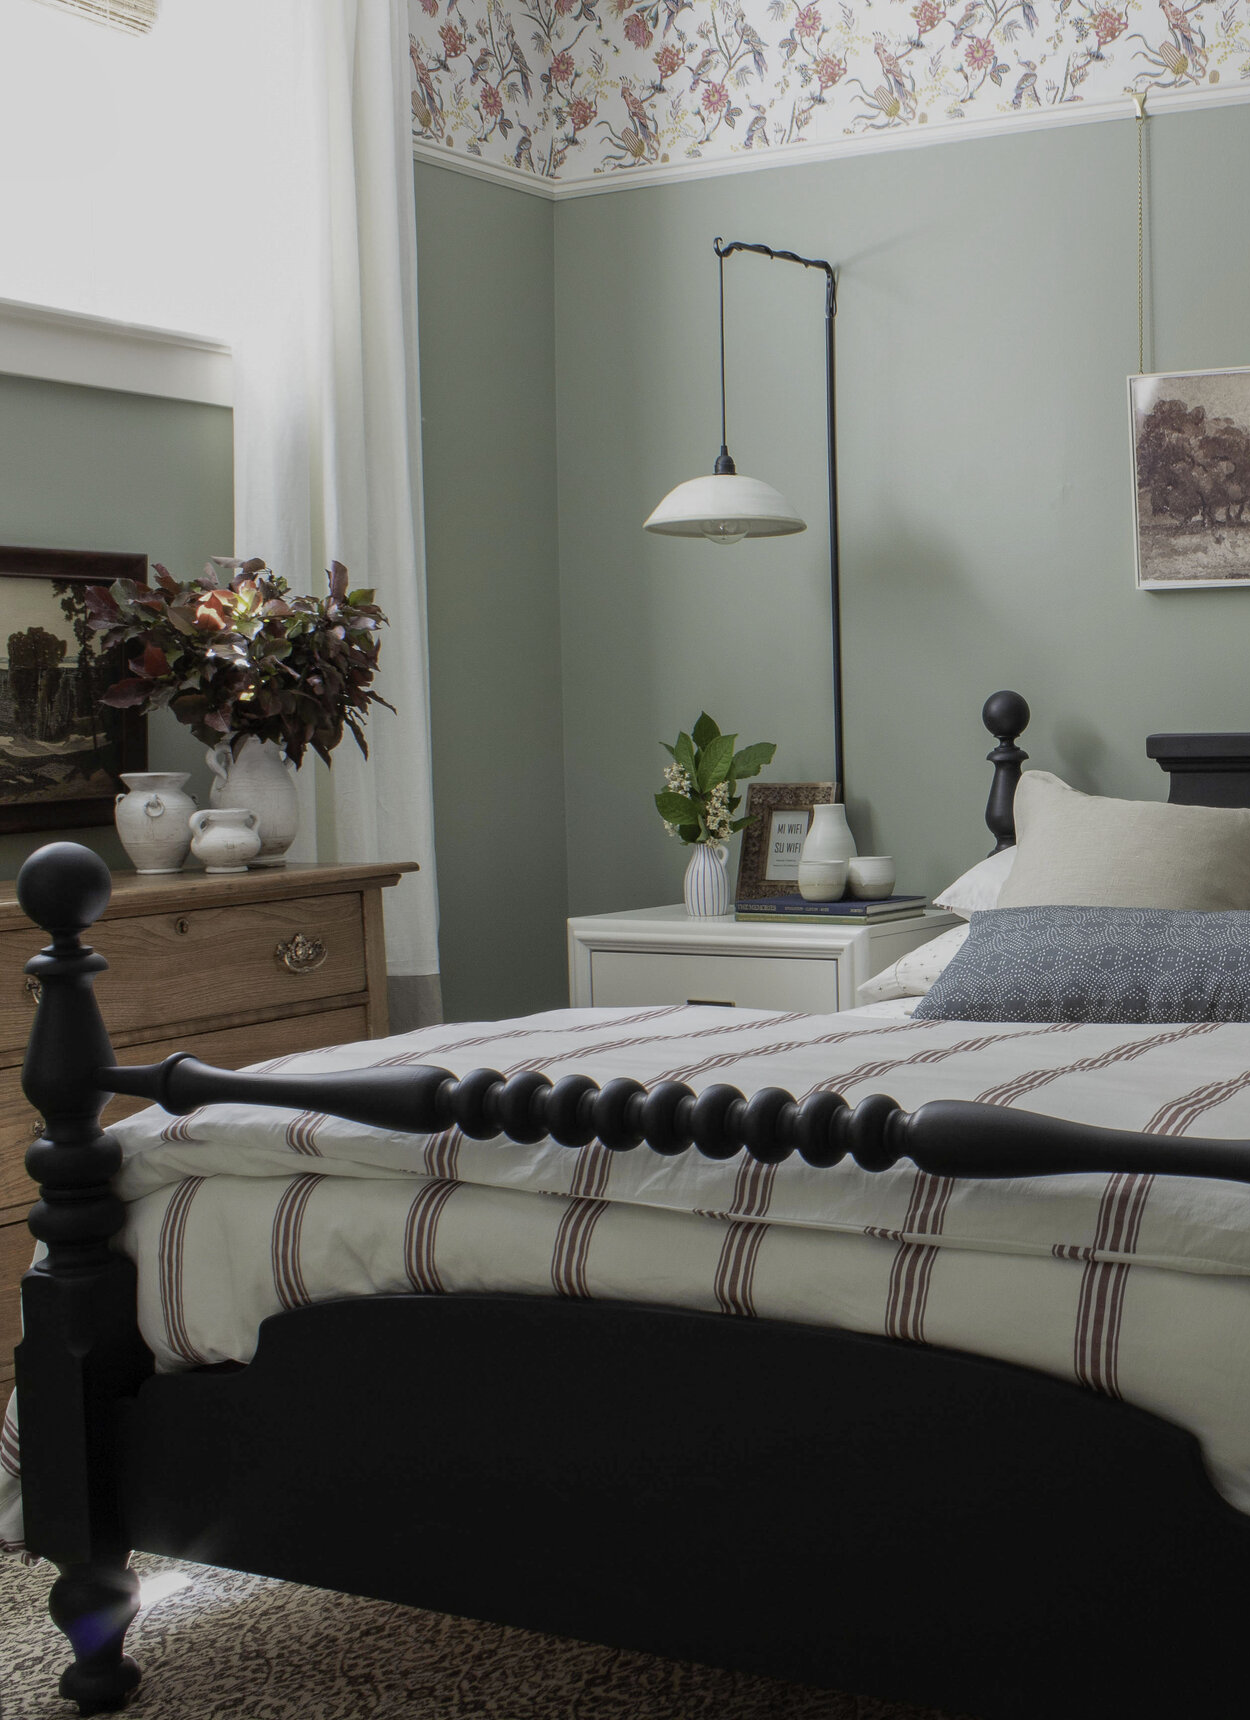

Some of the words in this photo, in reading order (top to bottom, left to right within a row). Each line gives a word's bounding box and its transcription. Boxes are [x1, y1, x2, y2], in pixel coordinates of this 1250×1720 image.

[777, 823, 786, 834] MI
[787, 823, 803, 834] WIFI
[774, 842, 785, 854] SU
[786, 842, 802, 854] WIFI
